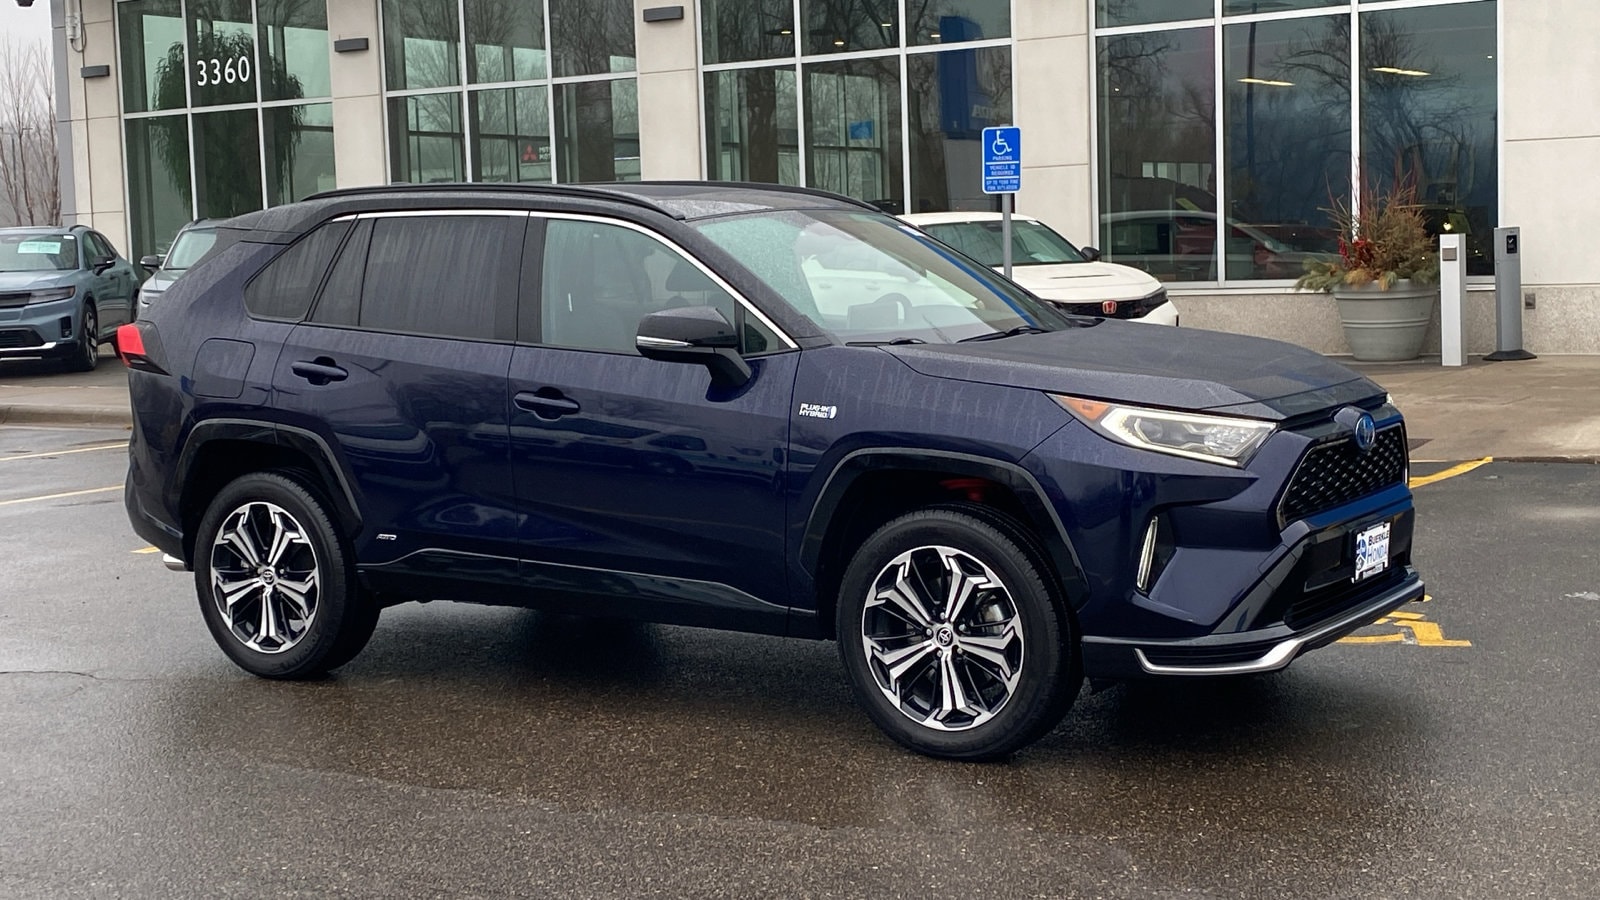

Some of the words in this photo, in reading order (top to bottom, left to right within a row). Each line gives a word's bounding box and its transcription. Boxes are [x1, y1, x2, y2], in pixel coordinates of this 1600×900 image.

[196, 55, 250, 86] 3360
[799, 410, 829, 418] HYBRID
[800, 403, 830, 411] PLUG-IN
[1368, 530, 1389, 546] BUERKLE
[1367, 543, 1388, 563] HONDA
